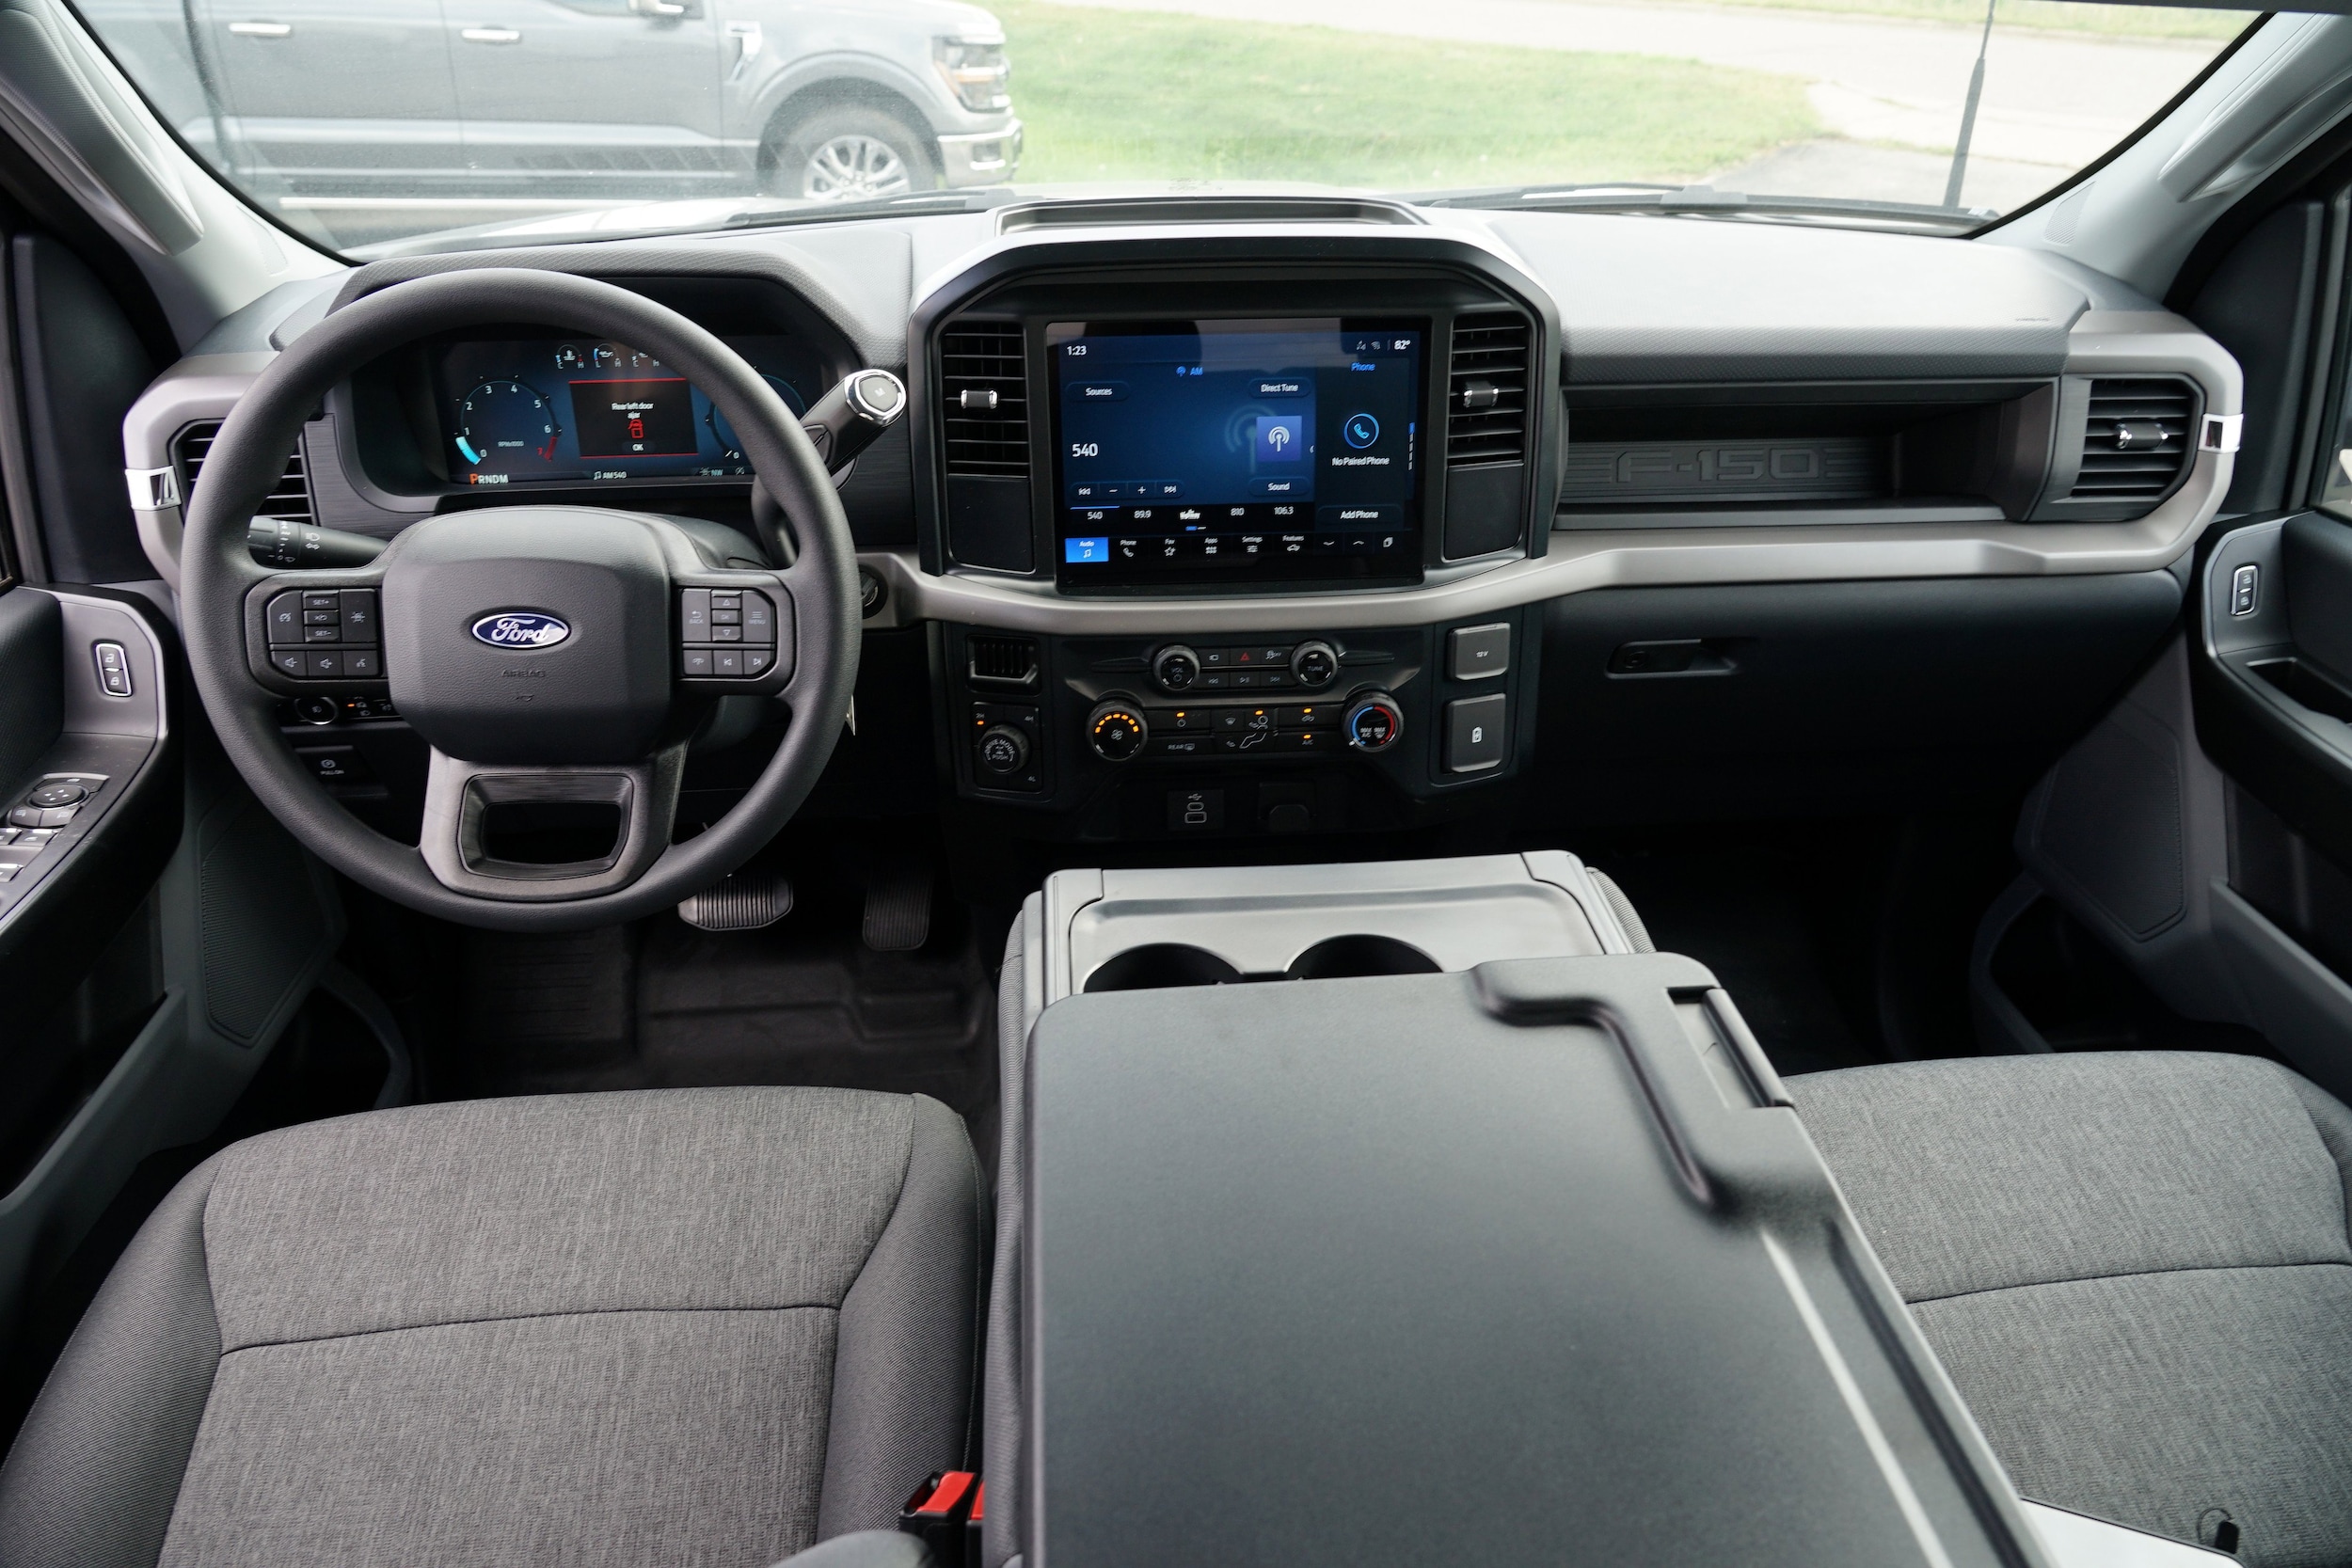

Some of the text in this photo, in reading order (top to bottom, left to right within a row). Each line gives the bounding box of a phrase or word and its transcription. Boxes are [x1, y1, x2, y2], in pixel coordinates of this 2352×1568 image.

[1067, 345, 1087, 356] 1:23
[1190, 367, 1203, 375] AM
[1351, 362, 1375, 372] Phone
[485, 386, 492, 394] 3
[511, 385, 517, 393] 4
[1086, 388, 1112, 396] Sources
[1261, 384, 1299, 393] Direct Tune
[466, 402, 472, 410] 2
[534, 400, 541, 408] 5
[612, 402, 654, 411] Rear left door
[464, 427, 469, 436] 1
[544, 425, 551, 434] 6
[537, 447, 543, 456] 7
[632, 443, 644, 451] OK
[1072, 443, 1099, 457] 540
[1343, 457, 1367, 466] Paired
[1367, 456, 1390, 466] Phone
[1616, 448, 1820, 483] F-150
[1268, 483, 1290, 491] Sound
[1134, 510, 1152, 518] 89.9
[1274, 506, 1294, 515] 106.3
[1340, 511, 1378, 519] Add Phone
[1088, 512, 1103, 520] 540
[491, 617, 550, 641] Ford
[501, 669, 546, 678] AIRBAG
